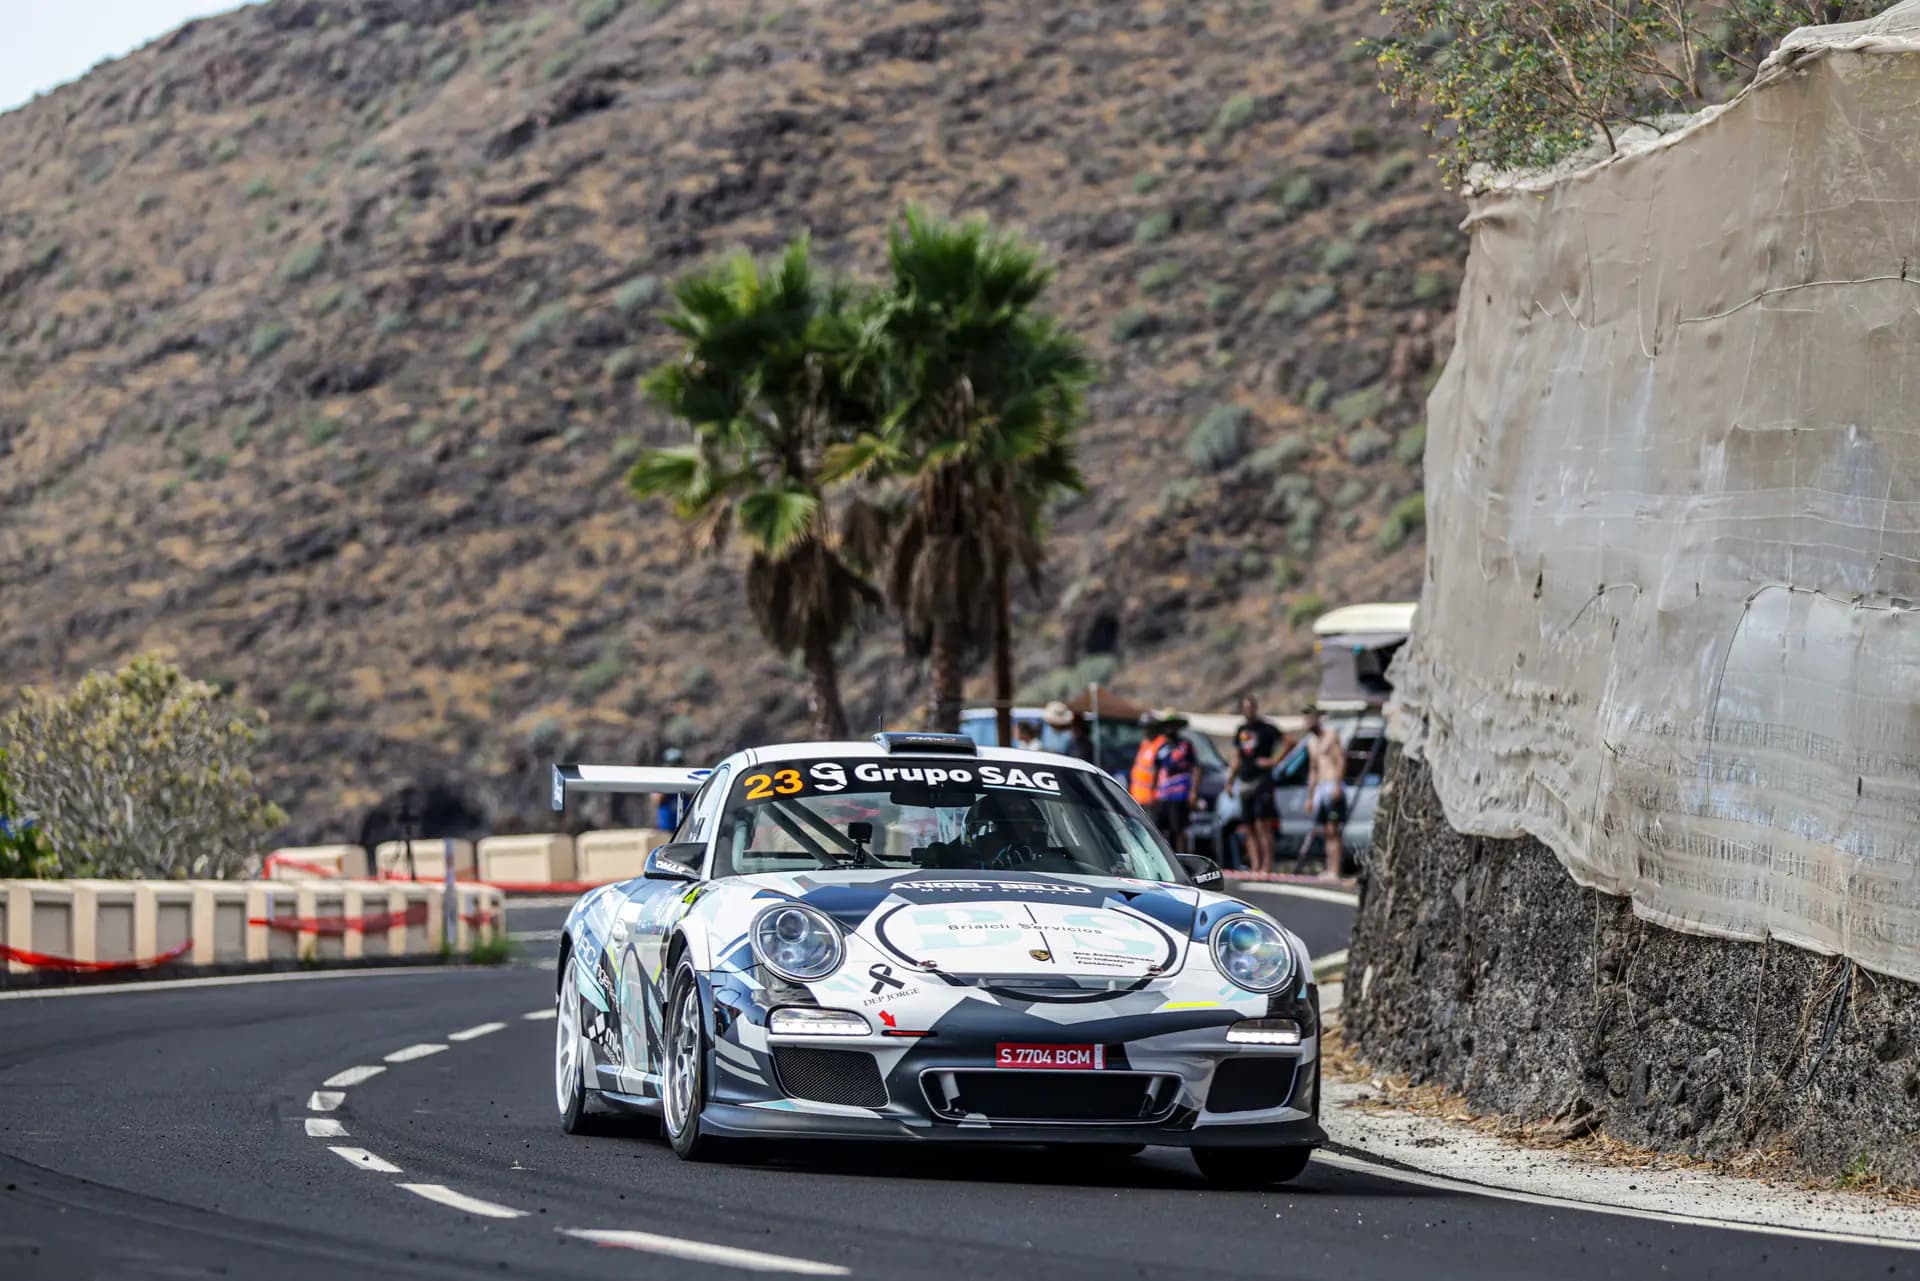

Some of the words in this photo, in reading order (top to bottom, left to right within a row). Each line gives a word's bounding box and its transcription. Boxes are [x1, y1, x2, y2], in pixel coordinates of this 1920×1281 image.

[743, 769, 803, 800] 23
[854, 763, 973, 786] Grupo
[979, 766, 1060, 791] SAG
[863, 995, 885, 1007] DEP
[886, 986, 921, 1003] JORGE
[1001, 1048, 1012, 1063] S
[1016, 1048, 1051, 1064] 7704
[1055, 1049, 1090, 1064] BCM
